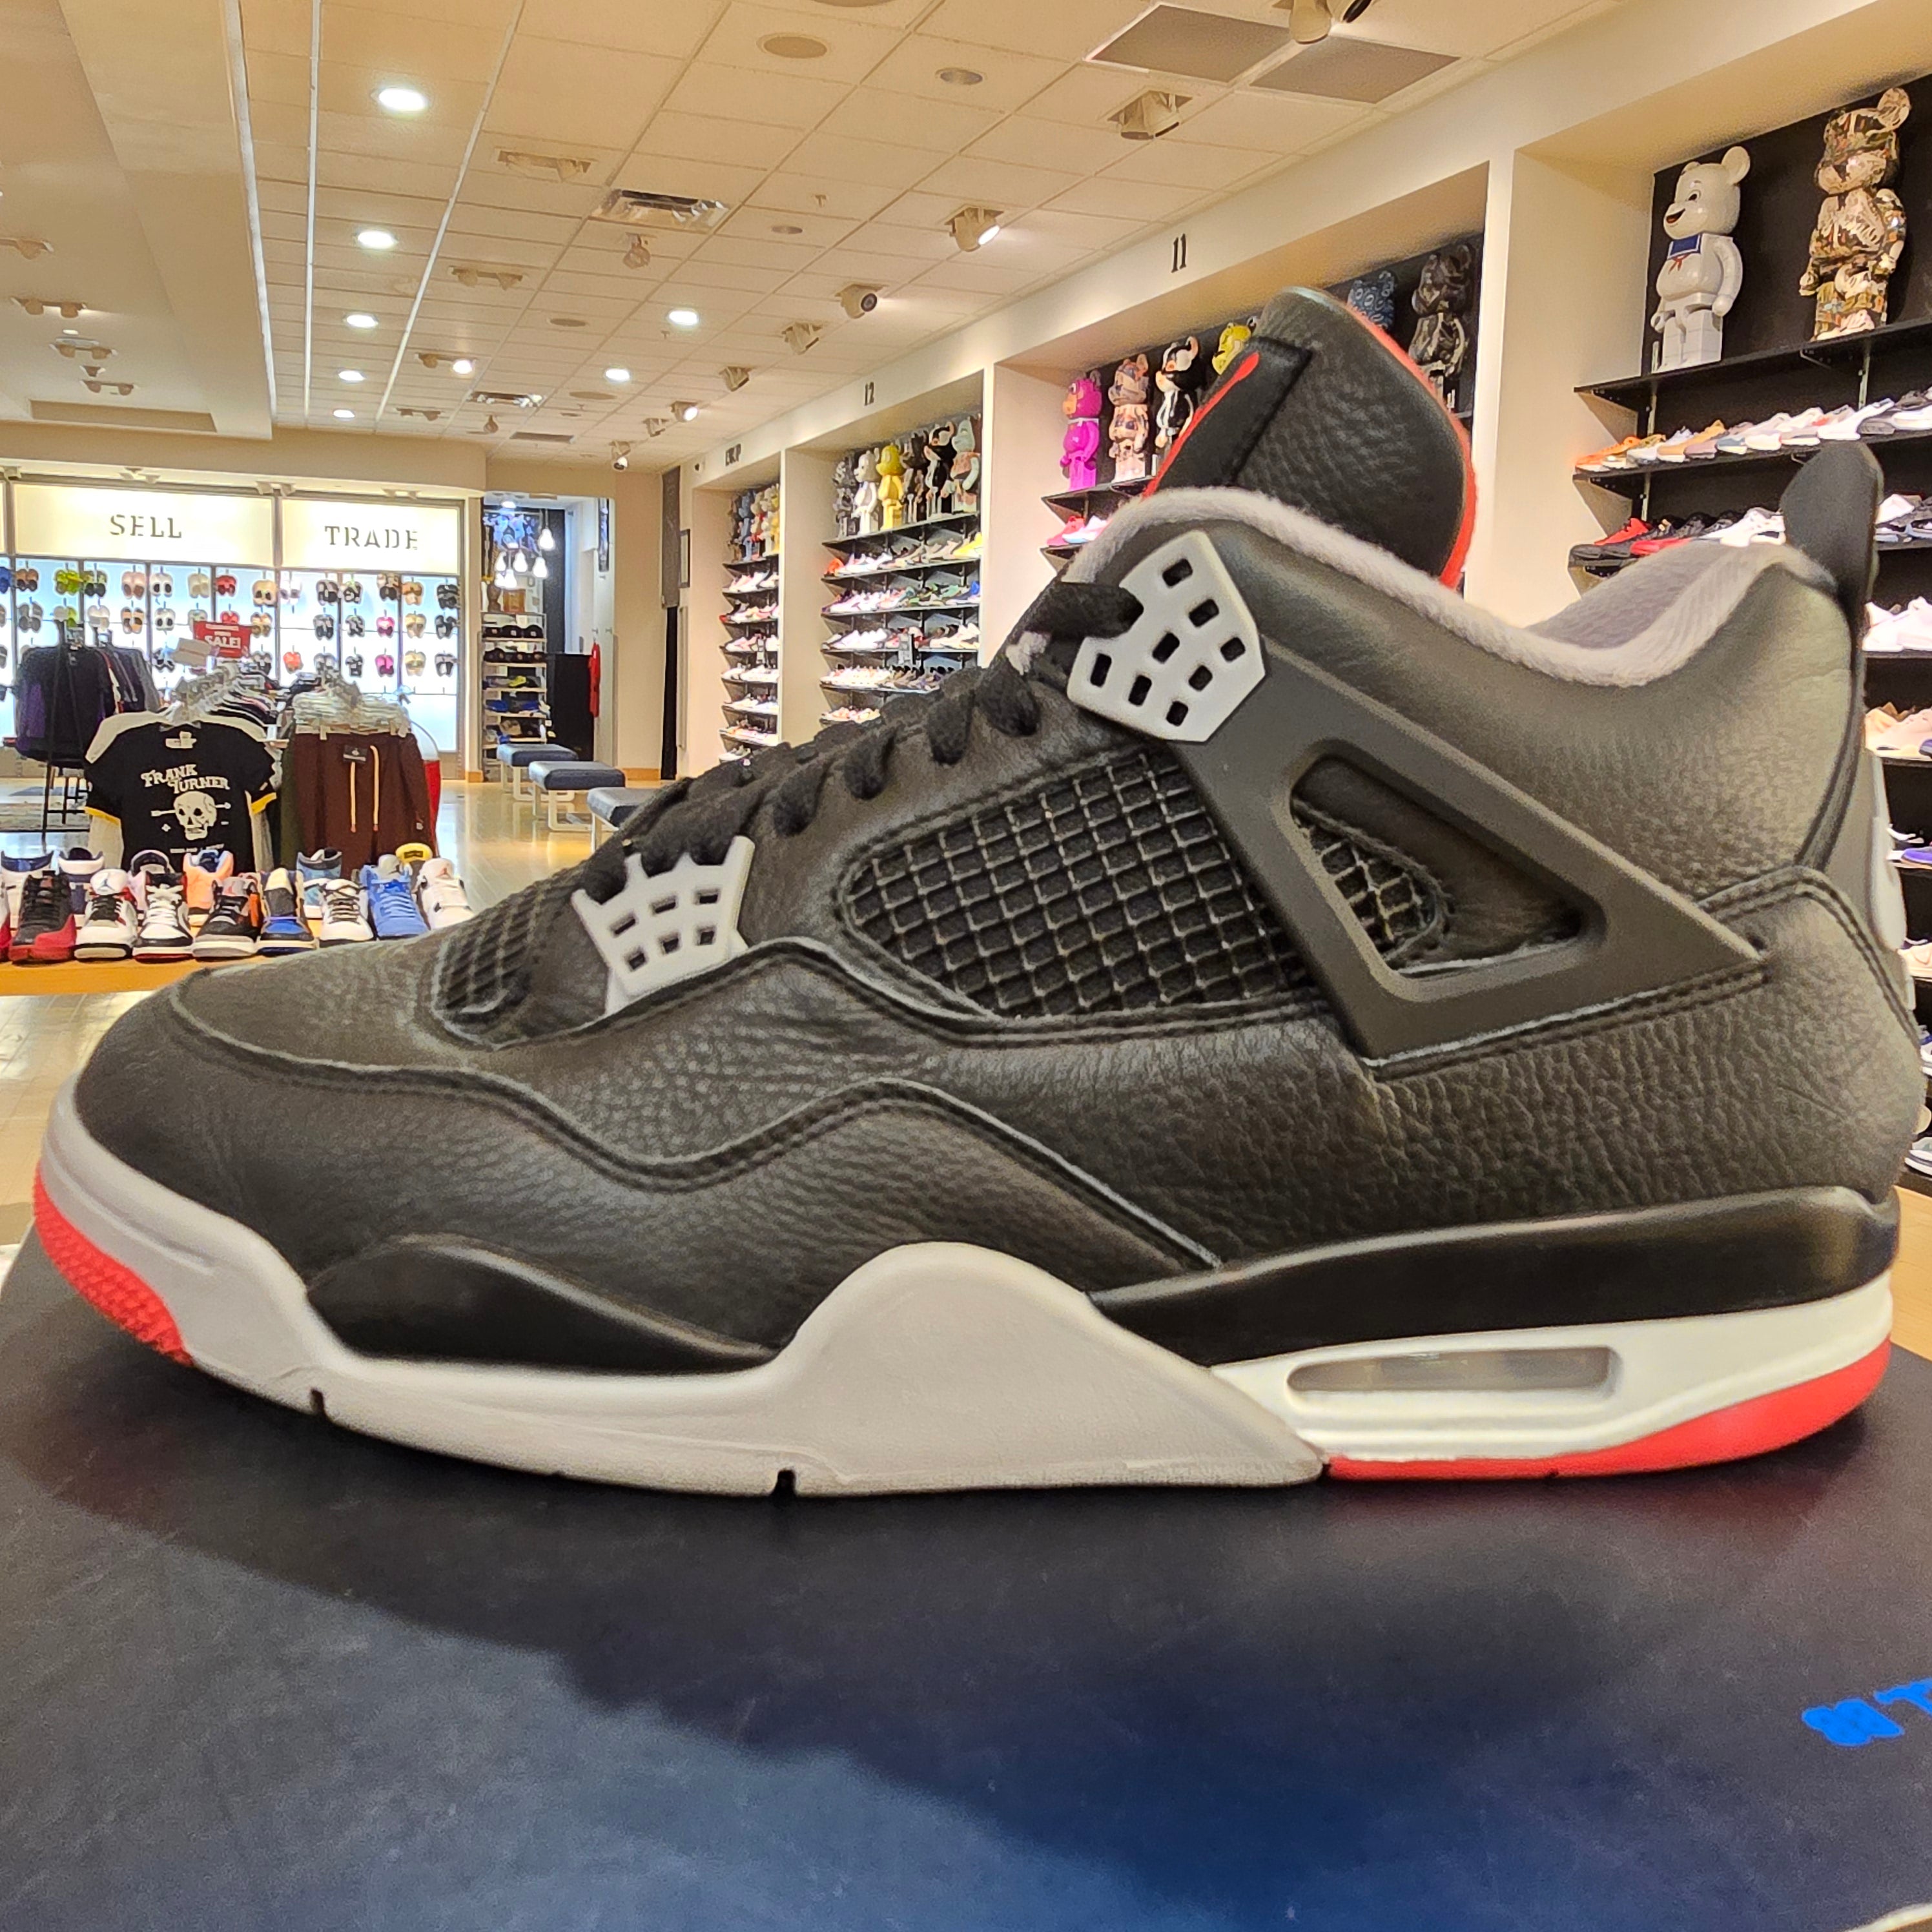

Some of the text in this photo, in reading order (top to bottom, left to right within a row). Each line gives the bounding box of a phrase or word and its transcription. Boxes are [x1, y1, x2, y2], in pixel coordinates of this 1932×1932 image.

[1171, 233, 1186, 273] 11
[865, 382, 874, 406] 12
[110, 514, 181, 538] SELL
[324, 526, 418, 550] TRADE
[141, 764, 198, 787] FRANK
[167, 776, 231, 794] TURNER
